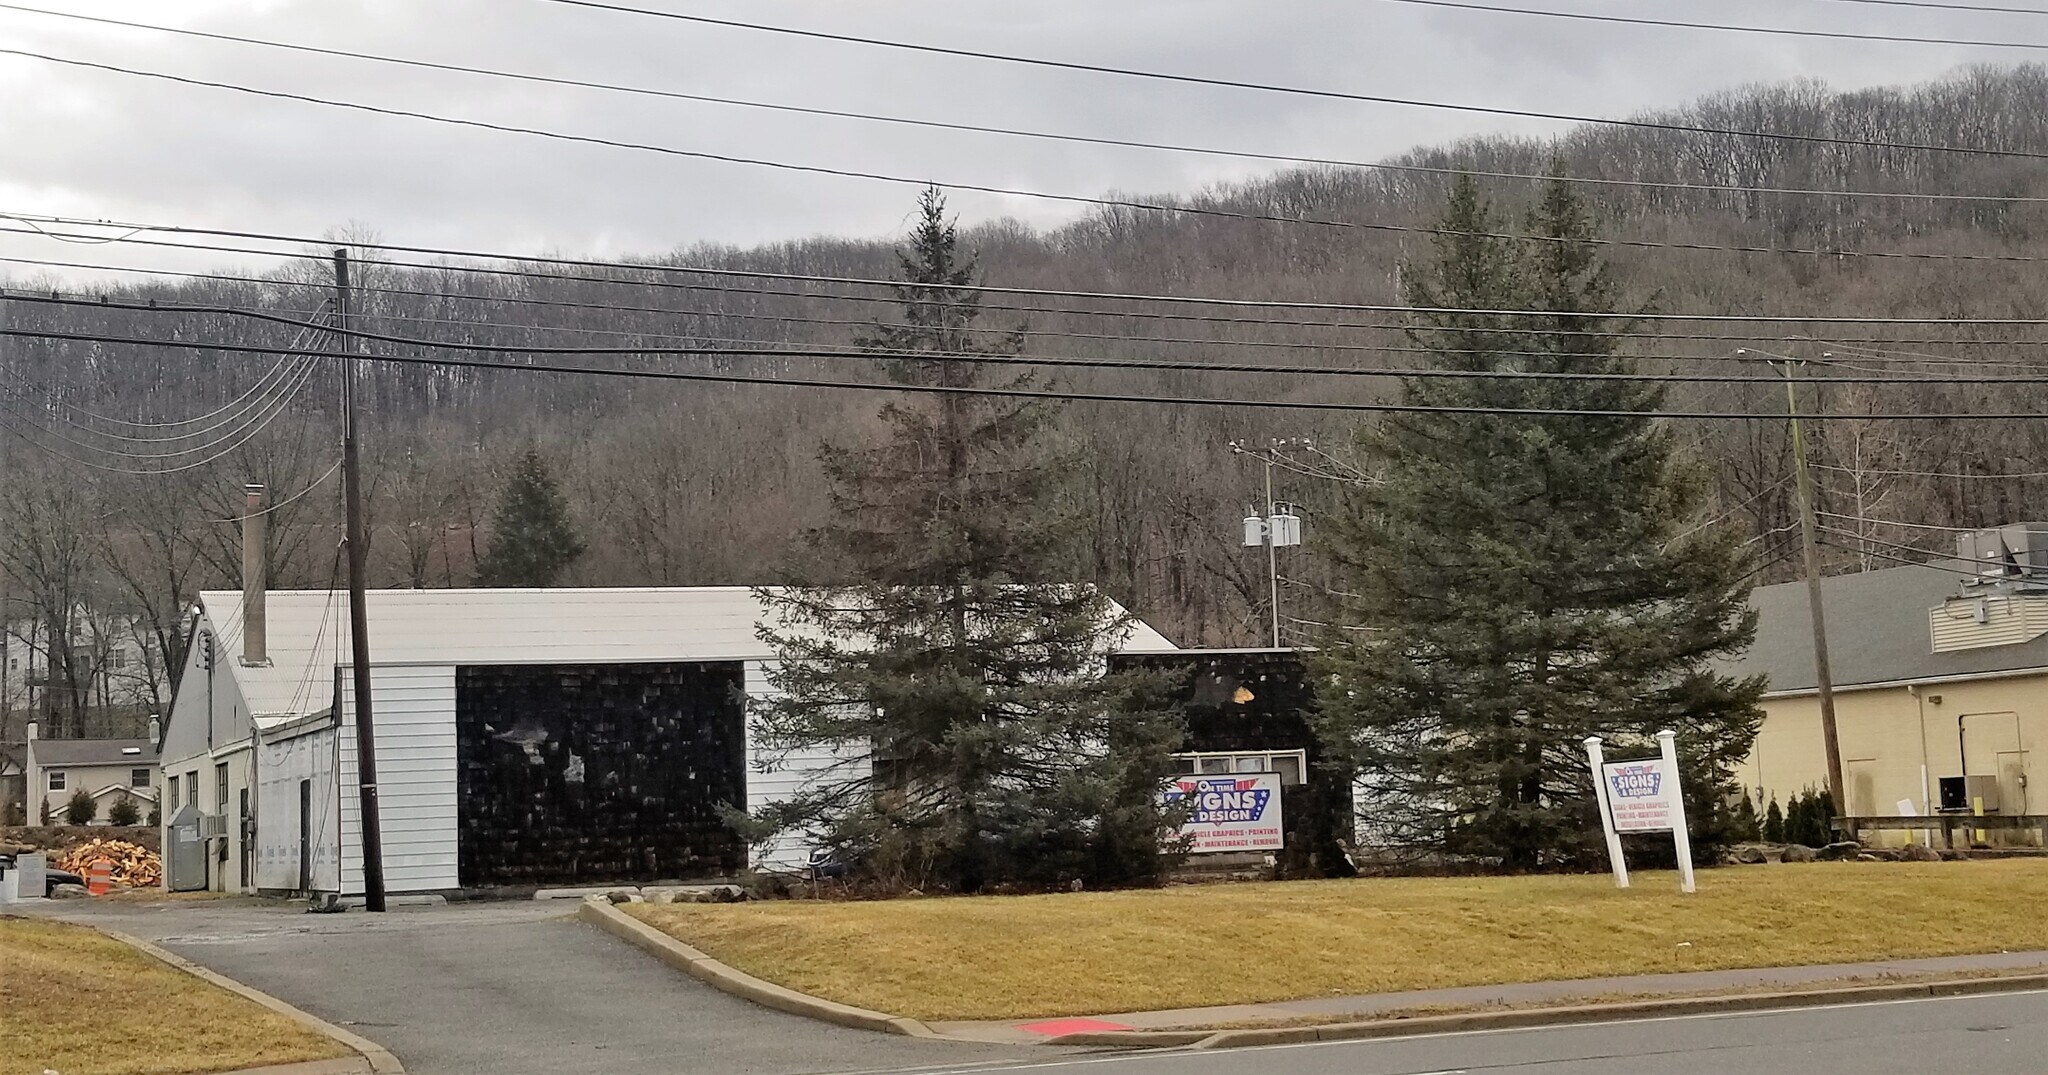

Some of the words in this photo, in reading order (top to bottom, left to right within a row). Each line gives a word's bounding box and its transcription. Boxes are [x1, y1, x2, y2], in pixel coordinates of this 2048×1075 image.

[1617, 774, 1655, 789] SIGNS
[1216, 784, 1235, 792] TIME
[1628, 788, 1654, 796] DESIGN
[1200, 810, 1250, 821] DESIGN
[1212, 829, 1245, 838] GRAPHICS
[1248, 828, 1279, 836] PRINTING
[1205, 839, 1249, 848] MAINTENANCE
